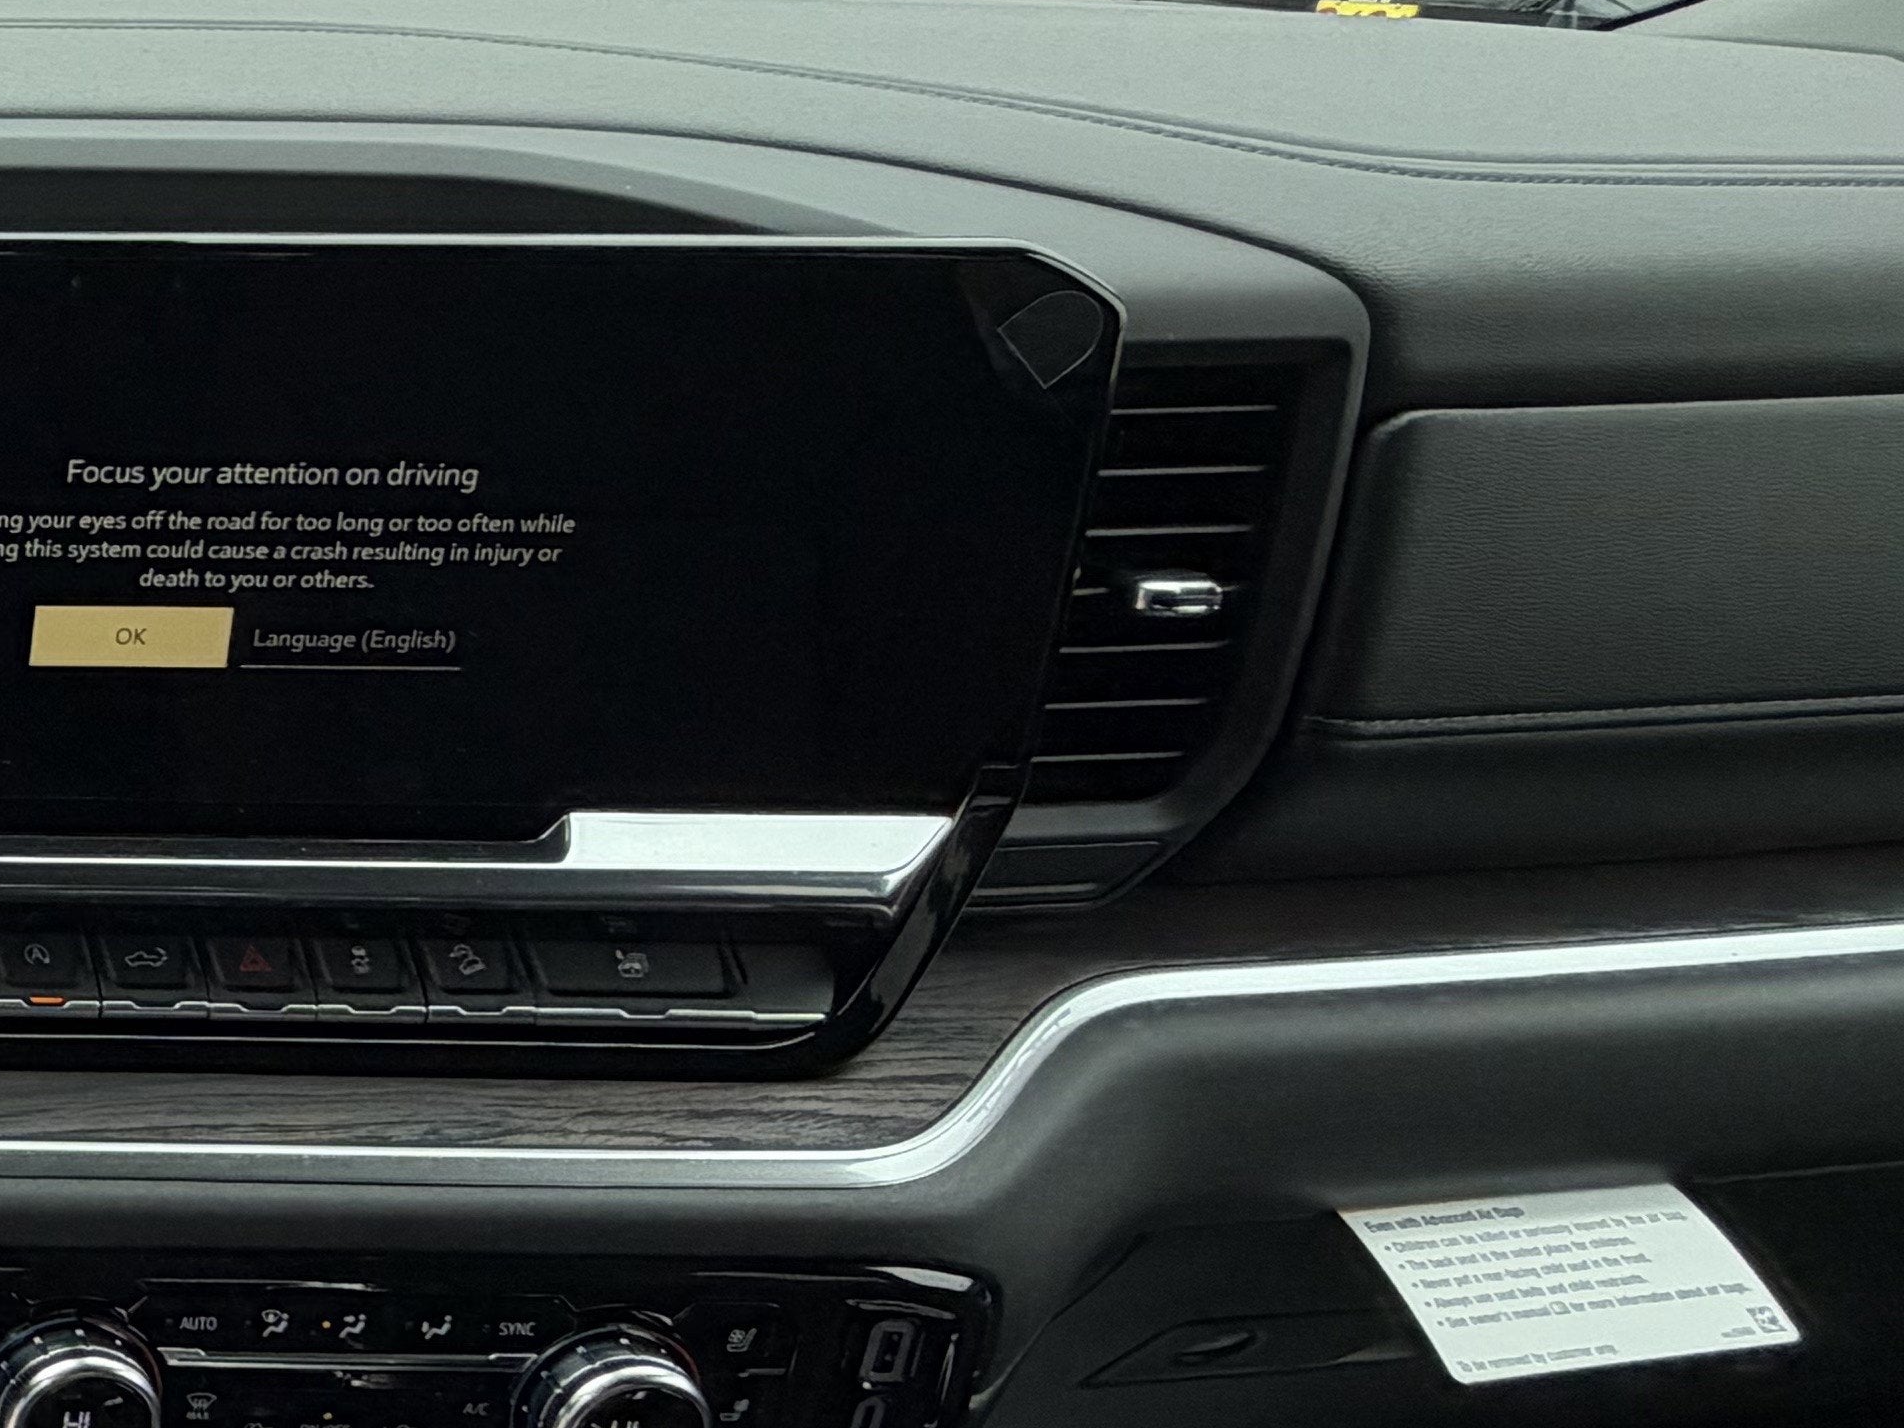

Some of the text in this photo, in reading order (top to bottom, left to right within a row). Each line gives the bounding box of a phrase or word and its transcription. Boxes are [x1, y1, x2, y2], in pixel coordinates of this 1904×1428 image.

[67, 459, 479, 493] Focus your attention on driving
[27, 513, 74, 533] your
[78, 513, 127, 533] eyes
[131, 510, 166, 529] off
[168, 511, 202, 529] the
[207, 511, 256, 530] road
[260, 510, 292, 530] for
[296, 514, 332, 531] too
[336, 511, 384, 536] long
[388, 518, 413, 532] or
[417, 515, 452, 532] too
[457, 512, 514, 533] often
[520, 513, 576, 533] while
[24, 538, 63, 558] this
[67, 541, 141, 563] system
[146, 539, 204, 559] could
[208, 545, 269, 559] cause
[273, 546, 286, 559] a
[290, 540, 348, 560] crash
[352, 541, 445, 565] resulting
[450, 543, 469, 561] in
[474, 543, 534, 567] injury
[537, 547, 562, 562] or
[139, 567, 375, 593] death to you or others.
[115, 627, 148, 646] OK
[253, 629, 456, 655] Language (English)
[179, 1315, 219, 1332] AUTO
[499, 1321, 537, 1337] SYNC
